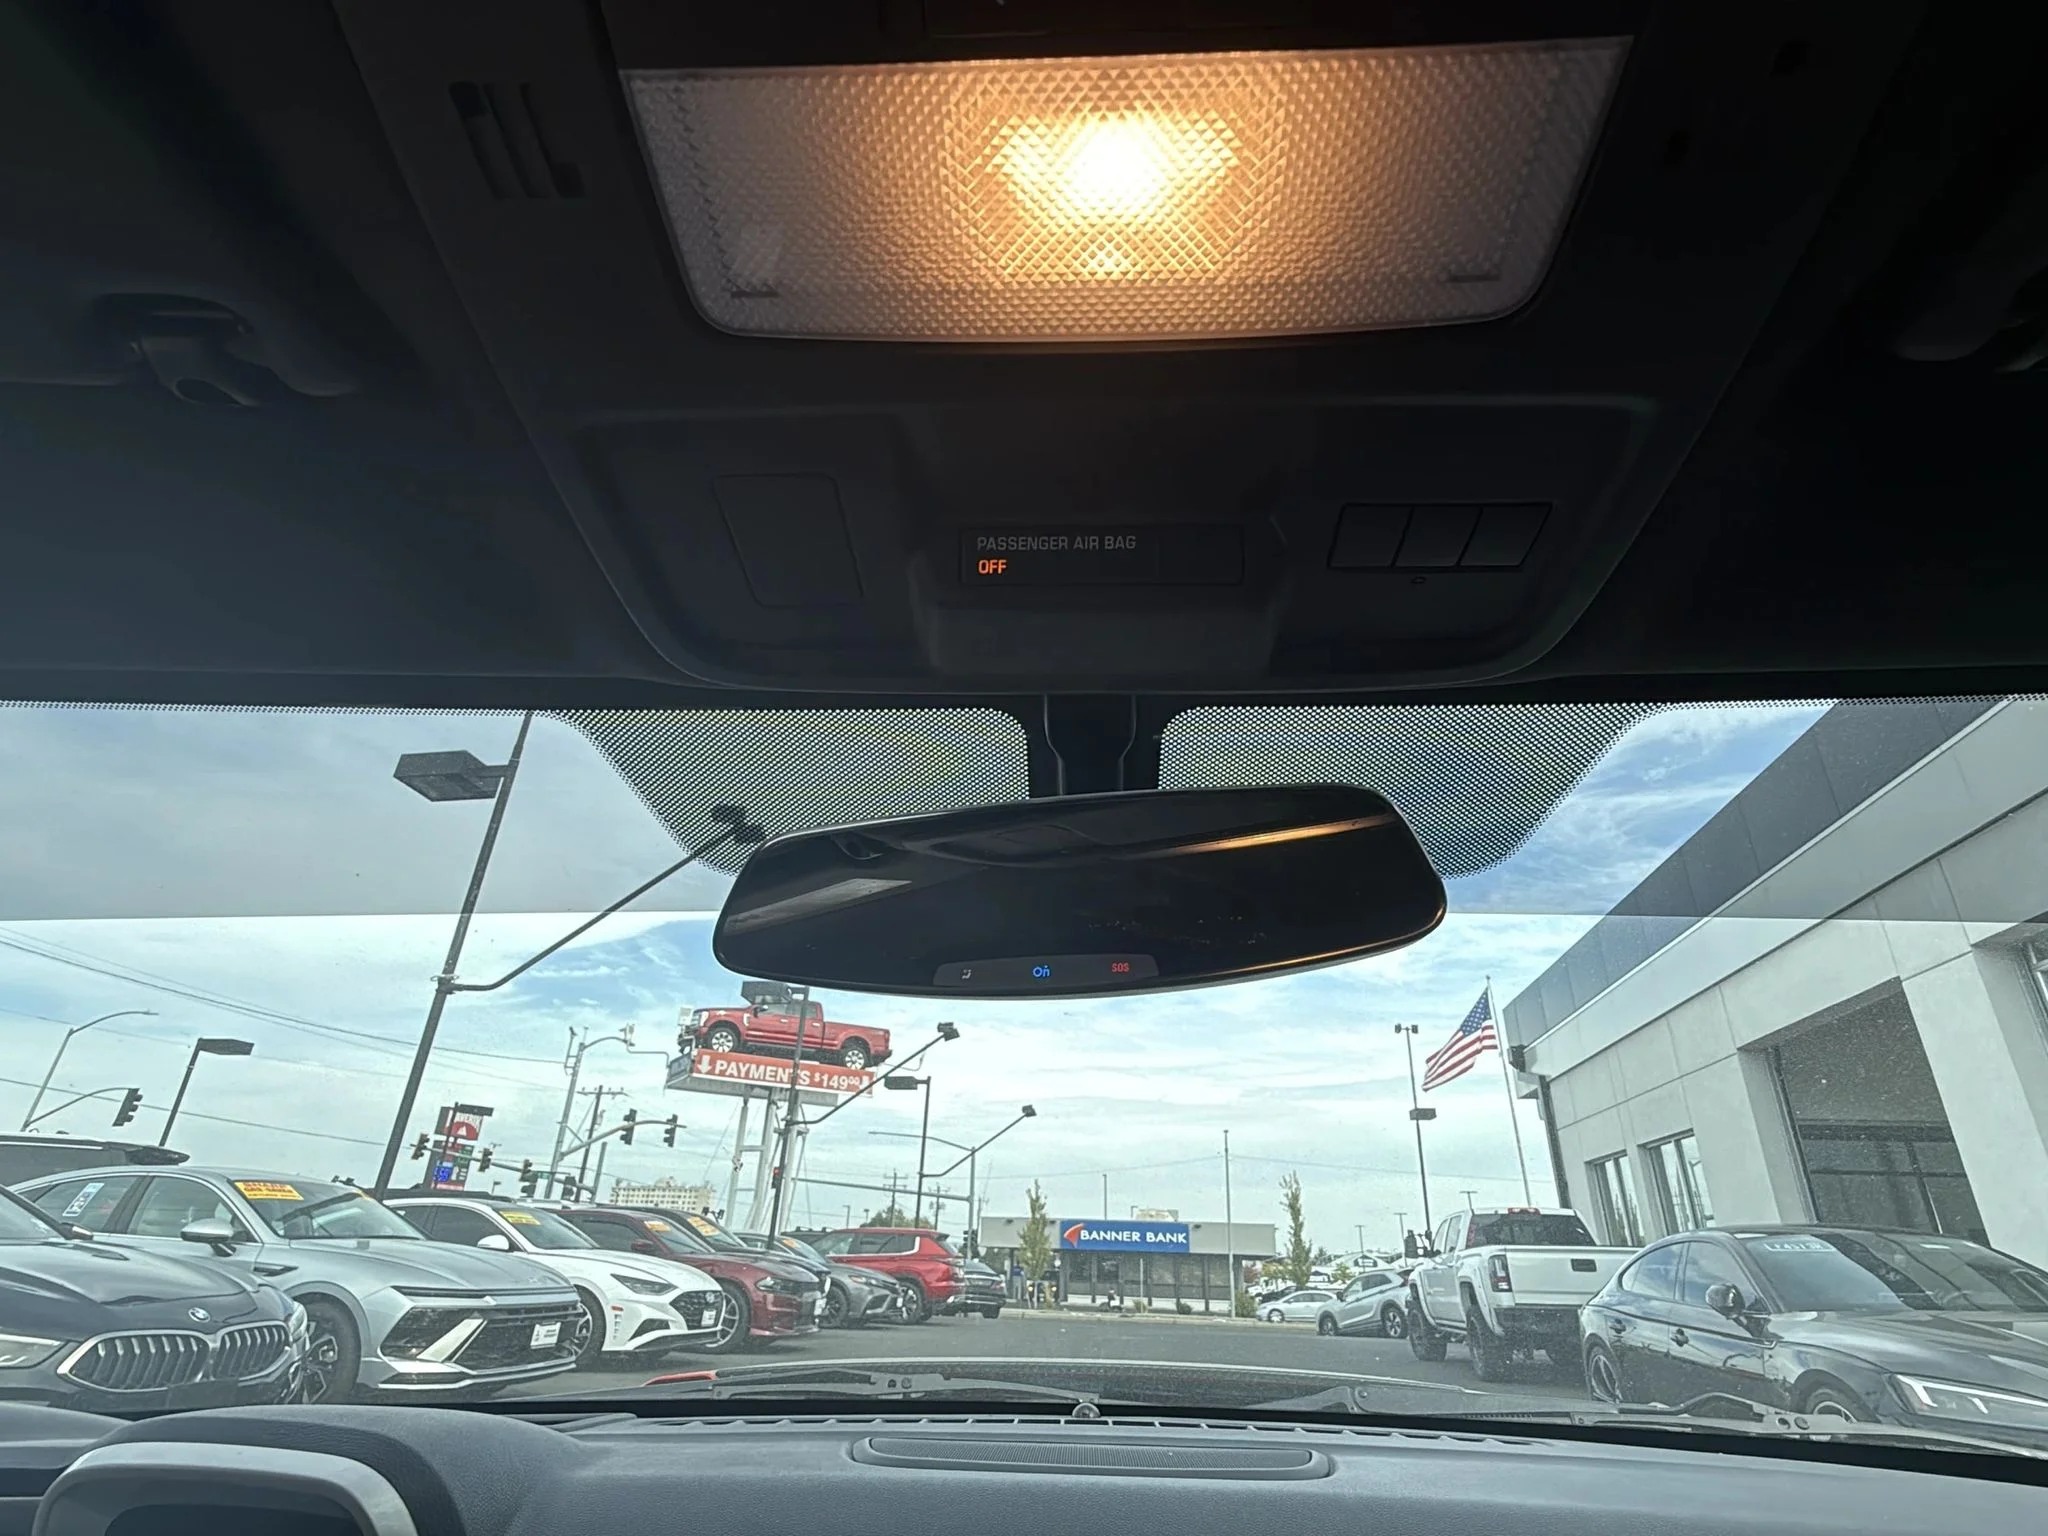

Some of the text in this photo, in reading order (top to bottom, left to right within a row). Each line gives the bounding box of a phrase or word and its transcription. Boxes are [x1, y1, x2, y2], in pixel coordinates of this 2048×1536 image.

[977, 535, 1136, 550] PASSENGER AIR BAG
[978, 560, 1007, 574] OFF
[1112, 963, 1129, 972] SOS
[1080, 1230, 1187, 1243] BANNER BANK
